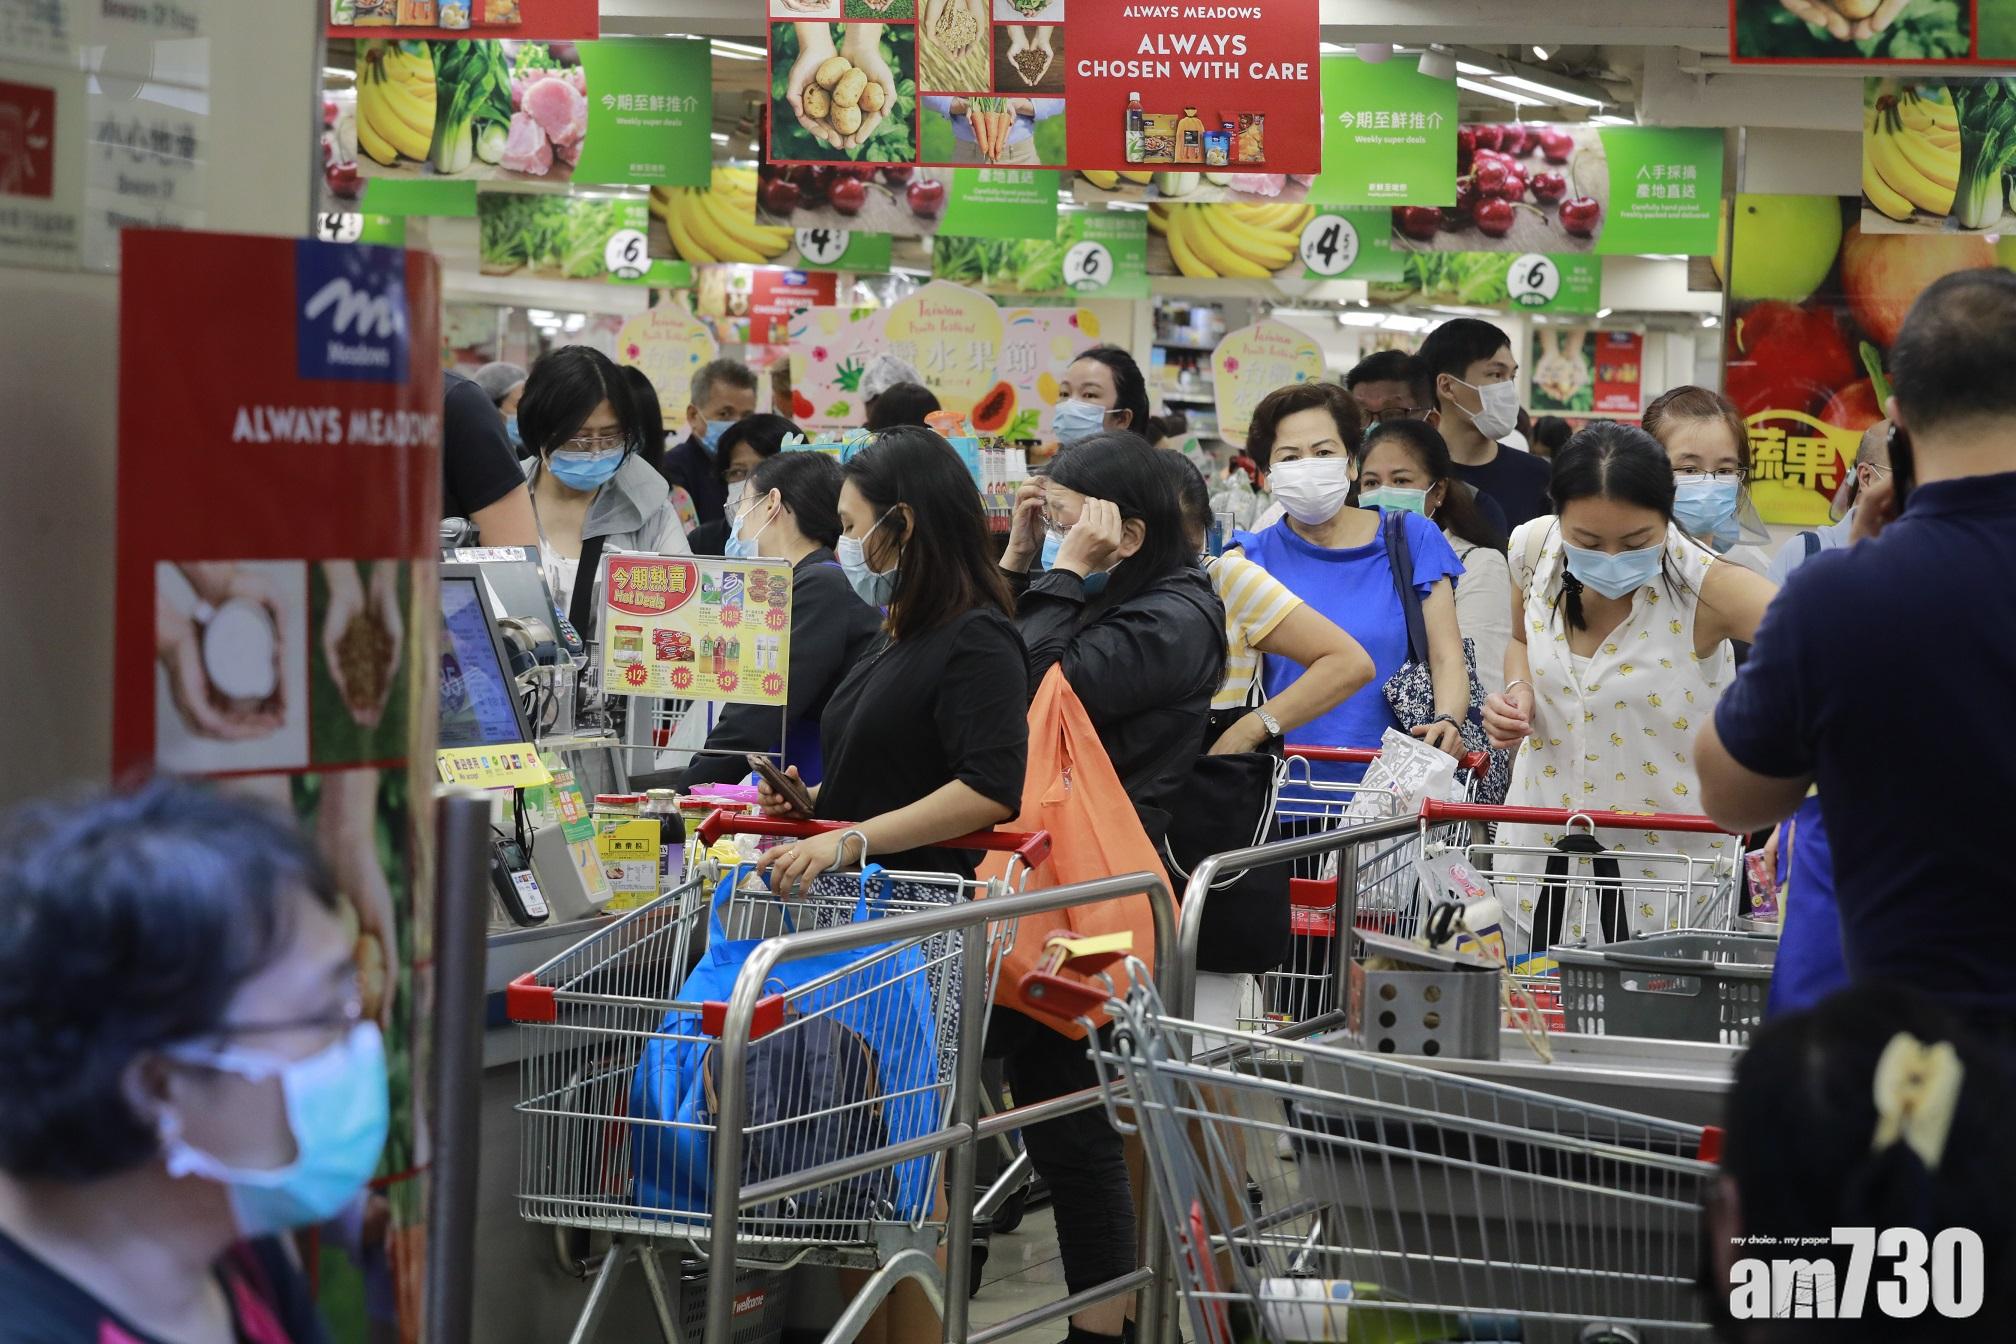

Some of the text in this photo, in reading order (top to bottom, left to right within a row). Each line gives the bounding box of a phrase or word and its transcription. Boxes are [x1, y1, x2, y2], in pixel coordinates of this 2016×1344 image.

[1123, 6, 1262, 19] ALWAYS MEADOWS
[1137, 34, 1248, 56] ALWAYS
[1077, 60, 1309, 80] CHOSEN WITH CARE
[601, 93, 698, 113] 今期至鮮推介
[1339, 111, 1444, 129] 今期至鮮推介
[1354, 135, 1426, 145] Weekly super deals
[1636, 183, 1697, 199] 產地直送
[624, 237, 641, 262] 6
[1317, 223, 1341, 267] 4
[1083, 249, 1100, 275] 6
[1527, 262, 1547, 288] 6
[232, 405, 343, 444] ALWAYS
[1748, 426, 1838, 490] 蔬果
[611, 565, 687, 594] 今期熱賣
[614, 588, 666, 610] Hot Deals
